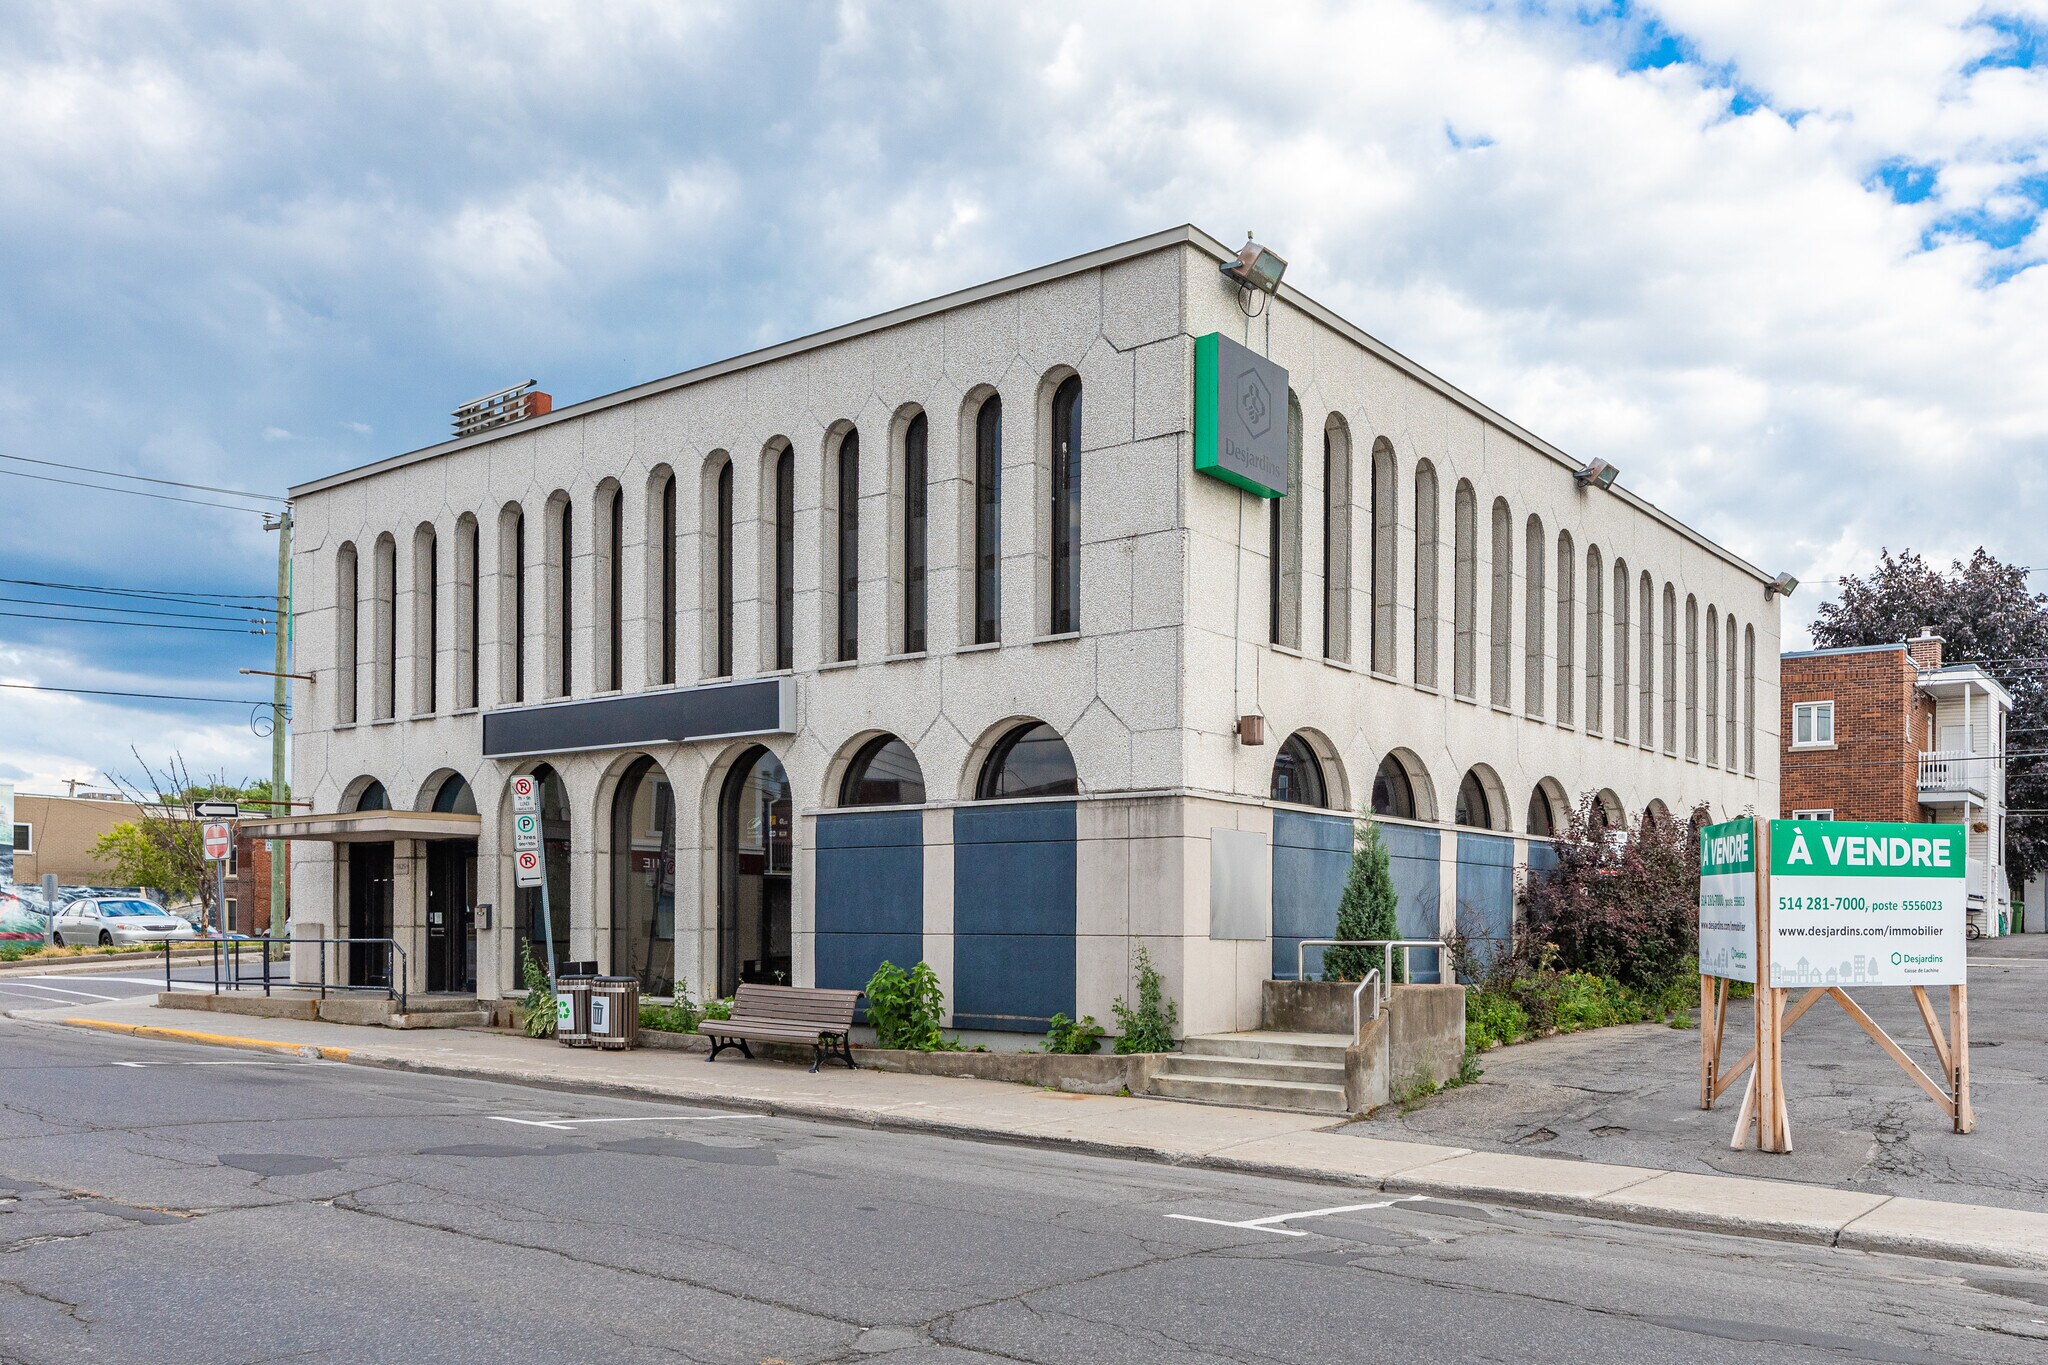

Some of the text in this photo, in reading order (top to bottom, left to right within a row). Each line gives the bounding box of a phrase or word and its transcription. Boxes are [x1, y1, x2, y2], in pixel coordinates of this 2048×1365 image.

[1225, 437, 1281, 477] Desjardins
[522, 819, 530, 829] P
[1703, 833, 1749, 866] À VENDRE
[1786, 826, 1951, 867] À VENDRE
[1778, 896, 1943, 913] 514 281-7000, poste 5556023
[1778, 925, 1944, 938] www.desjardins.com/immobilier
[1903, 954, 1943, 964] Desjardins
